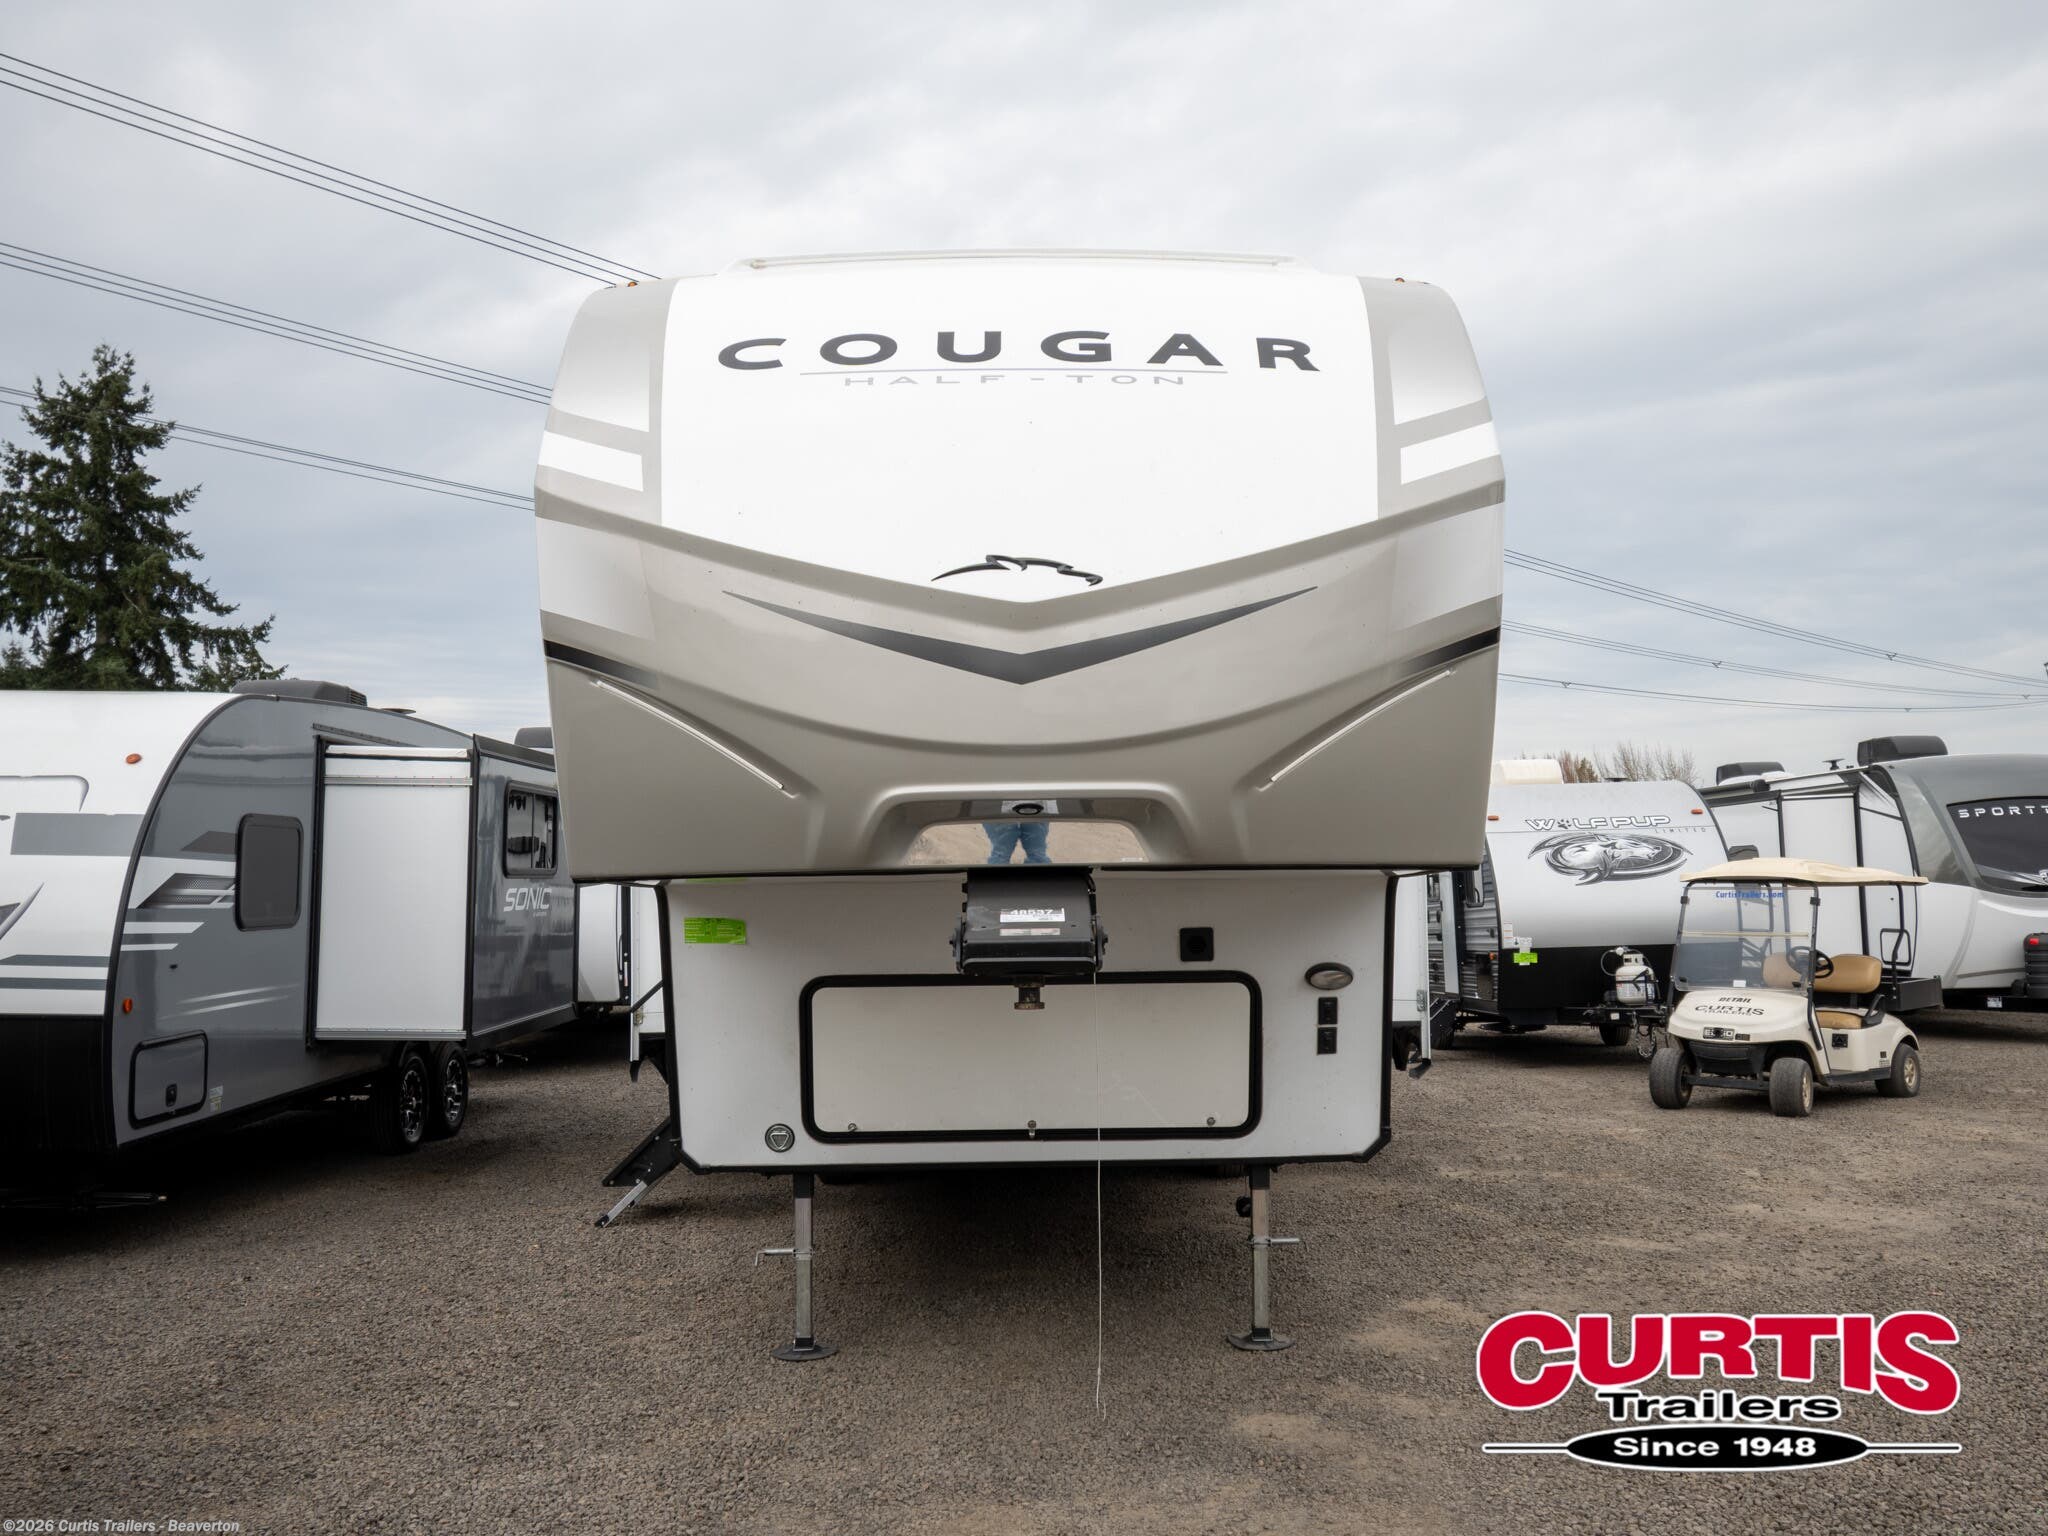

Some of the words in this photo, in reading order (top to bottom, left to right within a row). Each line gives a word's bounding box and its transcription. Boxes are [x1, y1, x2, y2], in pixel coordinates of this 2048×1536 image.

[717, 330, 1320, 372] COUGAR
[1612, 815, 1672, 829] PUP
[503, 887, 552, 912] SONIC
[1695, 1005, 1765, 1016] CURTIS
